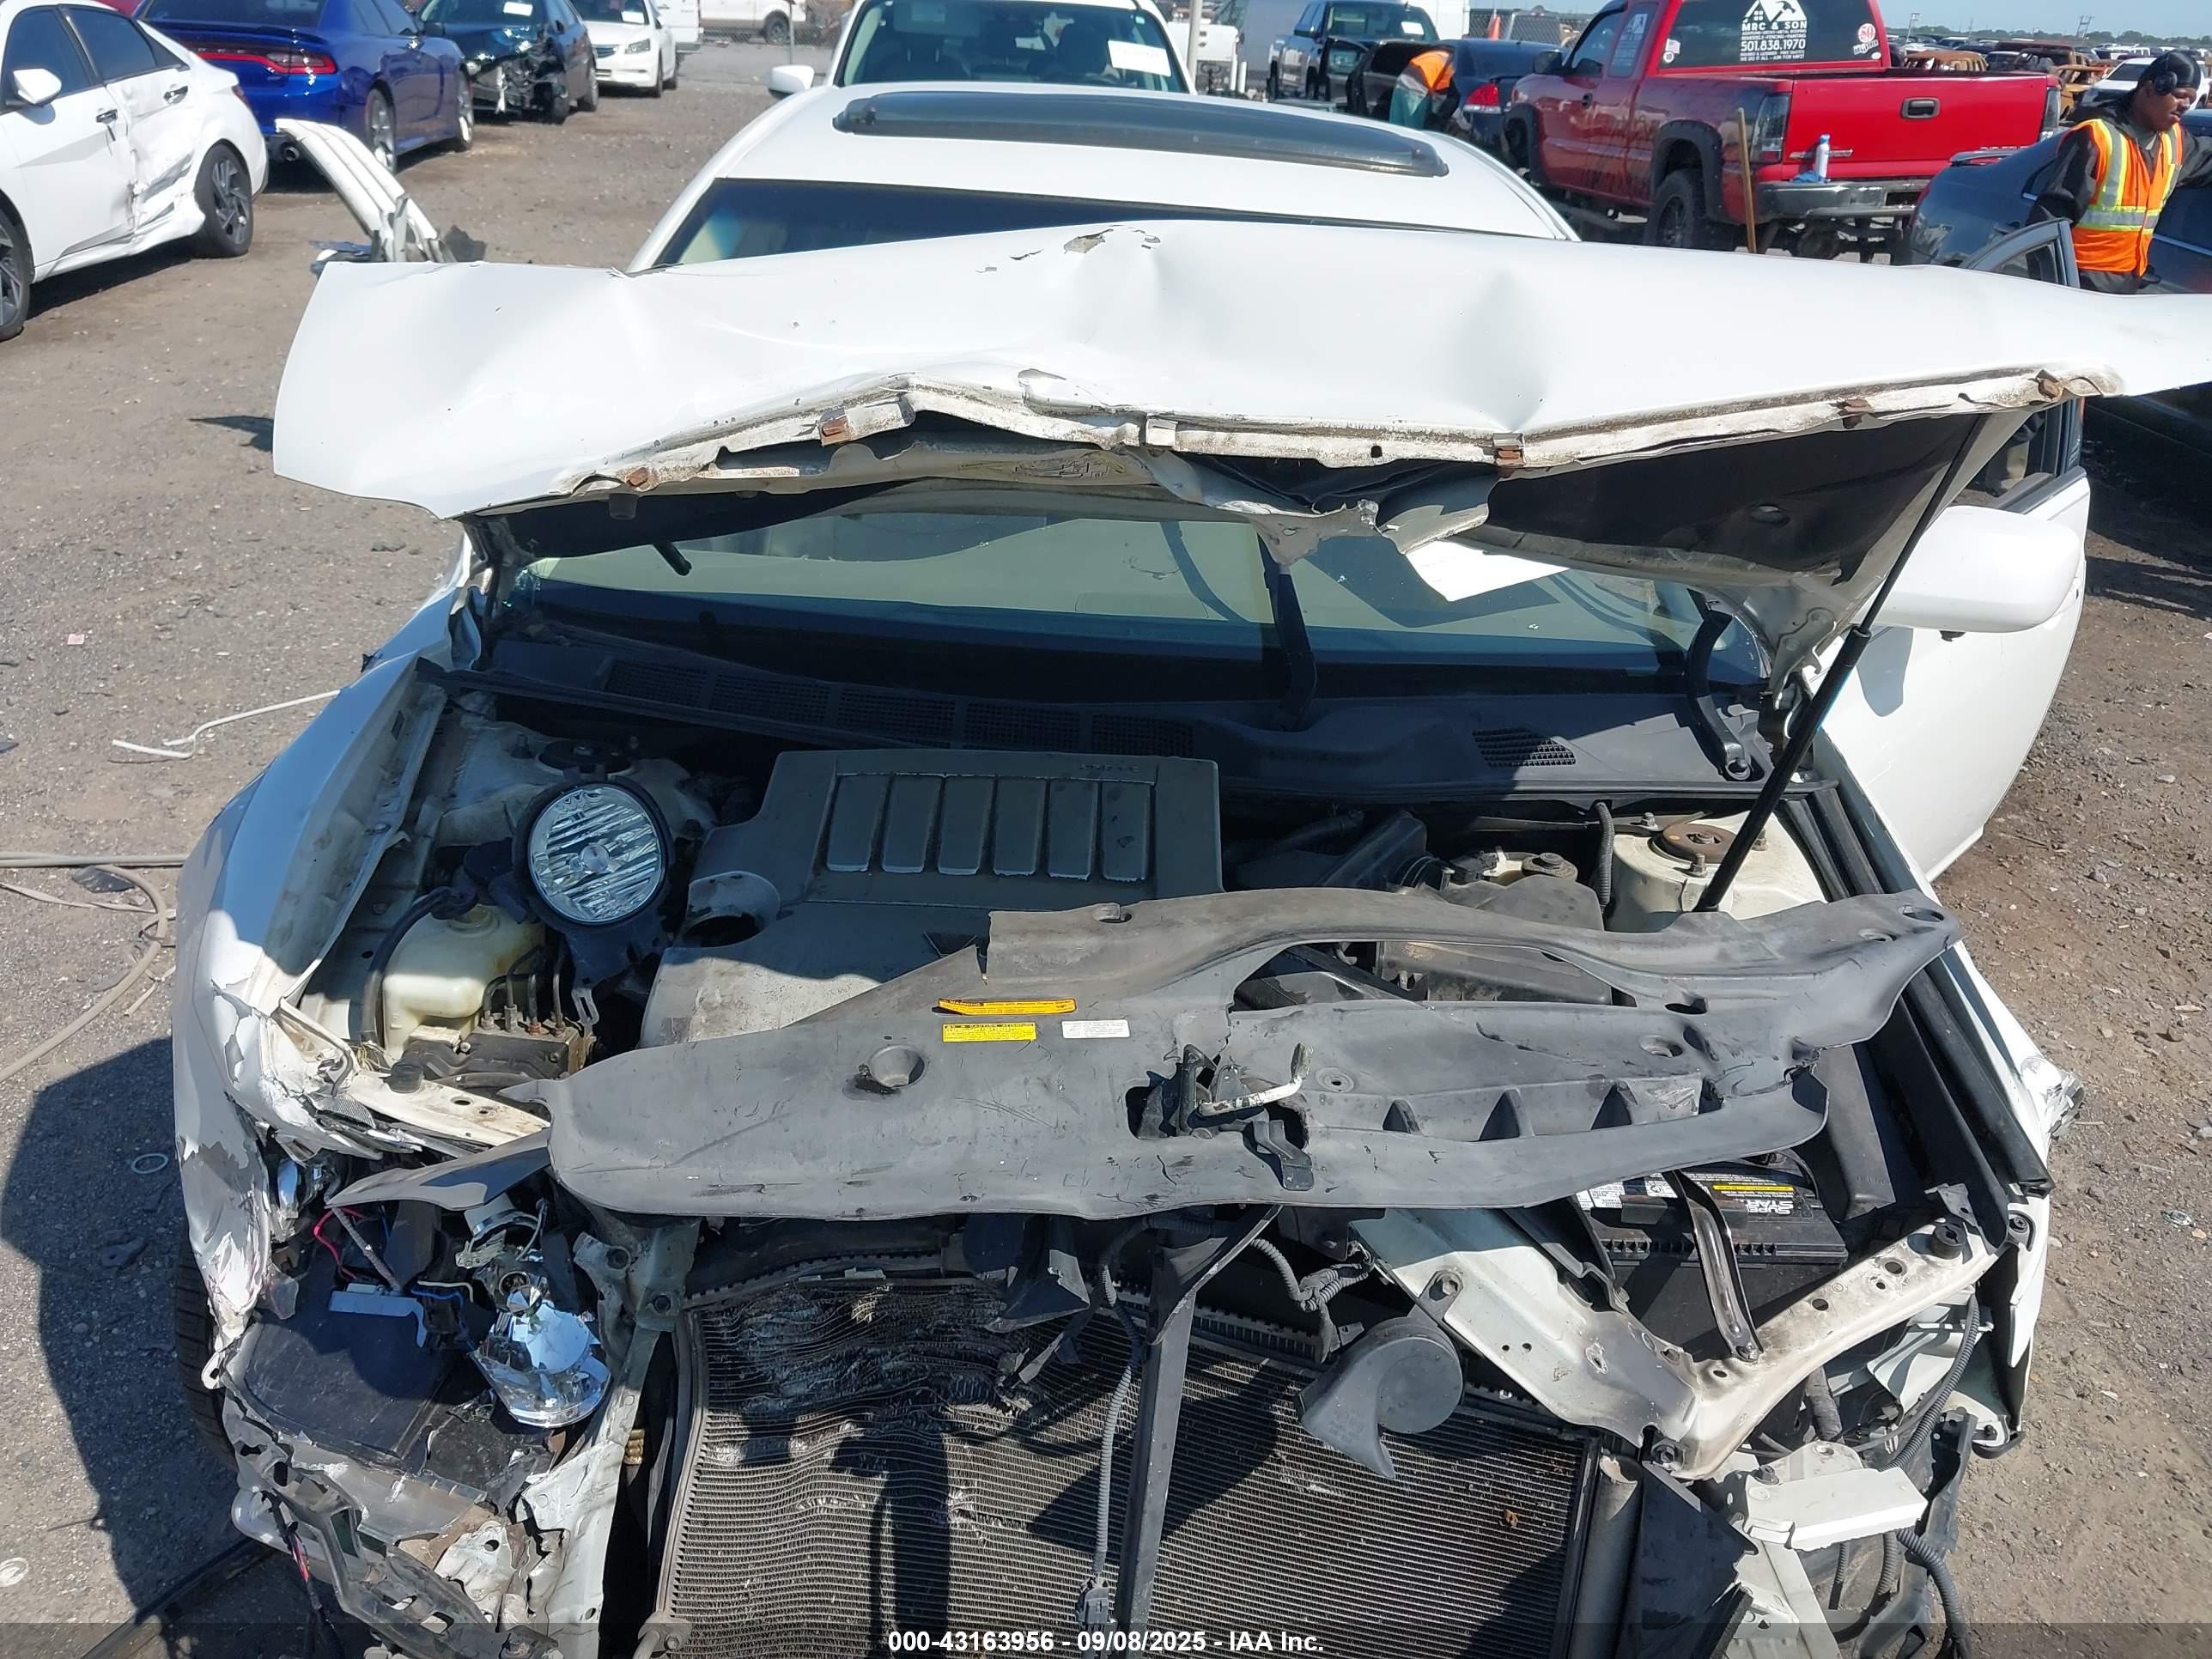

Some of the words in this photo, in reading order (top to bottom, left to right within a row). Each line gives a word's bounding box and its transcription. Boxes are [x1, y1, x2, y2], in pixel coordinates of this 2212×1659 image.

[1741, 22, 1766, 31] MRC
[1784, 21, 1808, 29] SON
[1741, 39, 1806, 52] 501.838.1970
